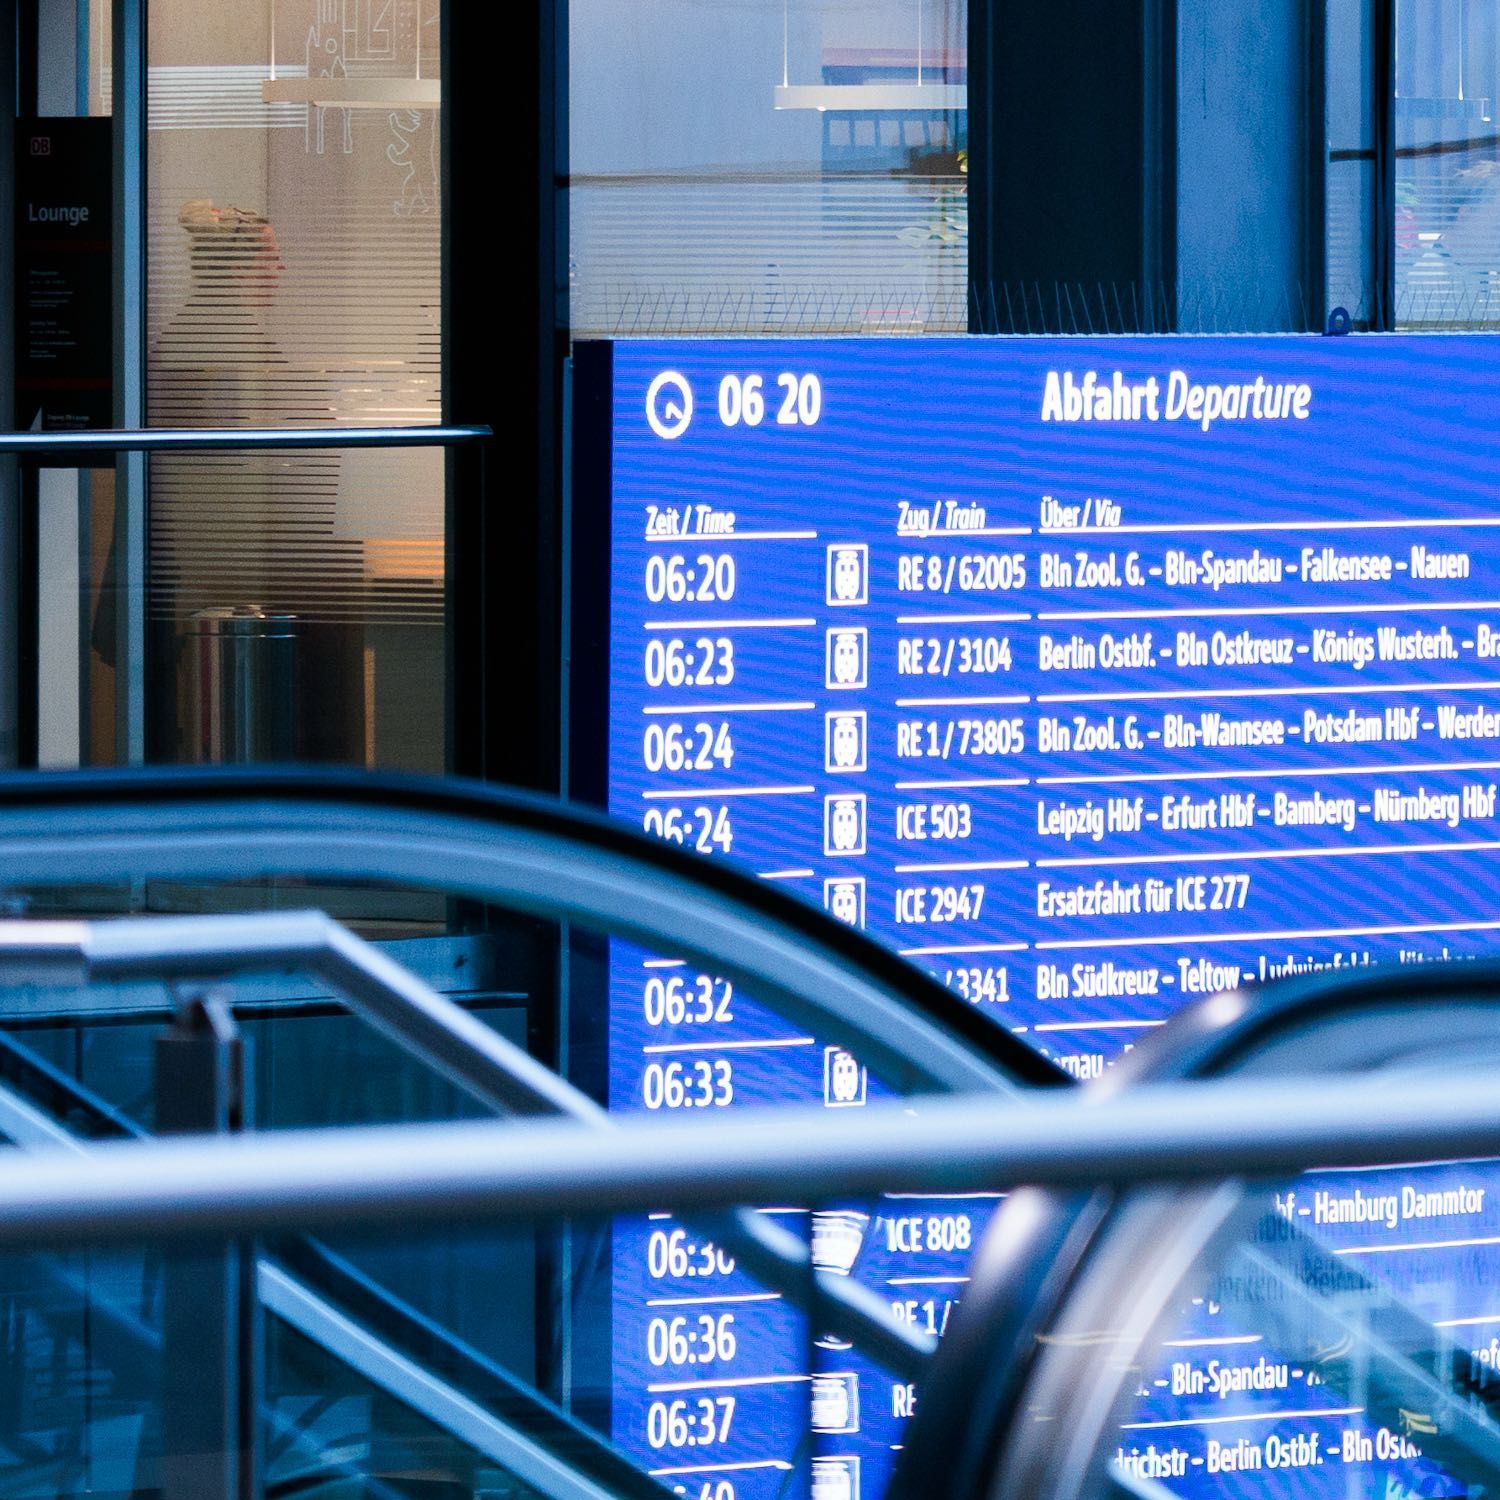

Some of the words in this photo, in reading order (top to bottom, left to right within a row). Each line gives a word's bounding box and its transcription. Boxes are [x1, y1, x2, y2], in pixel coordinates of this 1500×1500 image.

[29, 203, 89, 226] Lounge
[1041, 370, 1160, 422] Abfahrt
[1164, 372, 1312, 432] Departure
[645, 553, 736, 603] 06:20
[1039, 553, 1072, 588] Bln
[1074, 551, 1123, 588] Zool.
[1165, 549, 1282, 592] Bln-Spandau
[1301, 547, 1393, 583] Falkensee
[1410, 545, 1470, 579] Nauen
[644, 637, 735, 687] 06:23
[1039, 635, 1096, 671] Berlin
[1098, 632, 1157, 669] Ostbf.
[1176, 631, 1209, 667] Bln
[1210, 630, 1294, 666] Ostkreuz
[1312, 628, 1375, 670] Königs
[1376, 625, 1459, 661] Wusterh.
[643, 721, 735, 772] 06:24
[1038, 717, 1071, 753] Bln
[1072, 715, 1121, 752] Zool.
[1163, 712, 1285, 749] Bln-Wannsee
[1303, 708, 1383, 744] Potsdam
[1385, 706, 1420, 741] Hbf
[896, 803, 928, 840] ICE
[930, 802, 972, 840] 503
[1037, 800, 1105, 842] Leipzig
[1107, 796, 1144, 833] Hbf
[1161, 794, 1218, 831] Erfurt
[1219, 792, 1256, 828] Hbf
[1274, 791, 1356, 832] Bamberg
[1374, 786, 1460, 828] Nürnberg
[1462, 783, 1497, 819] Hbf
[895, 887, 927, 924] ICE
[930, 884, 985, 922] 2947
[1037, 880, 1142, 918] Ersatzfahrt
[1144, 878, 1174, 913] für
[1176, 875, 1207, 912] ICE
[1209, 874, 1250, 910] 277
[643, 975, 734, 1026] 06:32
[1036, 964, 1069, 1000] Bln
[1071, 961, 1159, 998] Südkreuz
[1177, 957, 1240, 993] Teltow
[643, 1059, 734, 1110] 06:33
[1314, 1189, 1398, 1229] Hamburg
[1401, 1185, 1485, 1219] Dammtor
[884, 1217, 924, 1253] ICE
[926, 1215, 972, 1252] 808
[647, 1313, 737, 1367] 06:36
[1171, 1356, 1288, 1400] Bln-Spandau
[647, 1396, 736, 1449] 06:37
